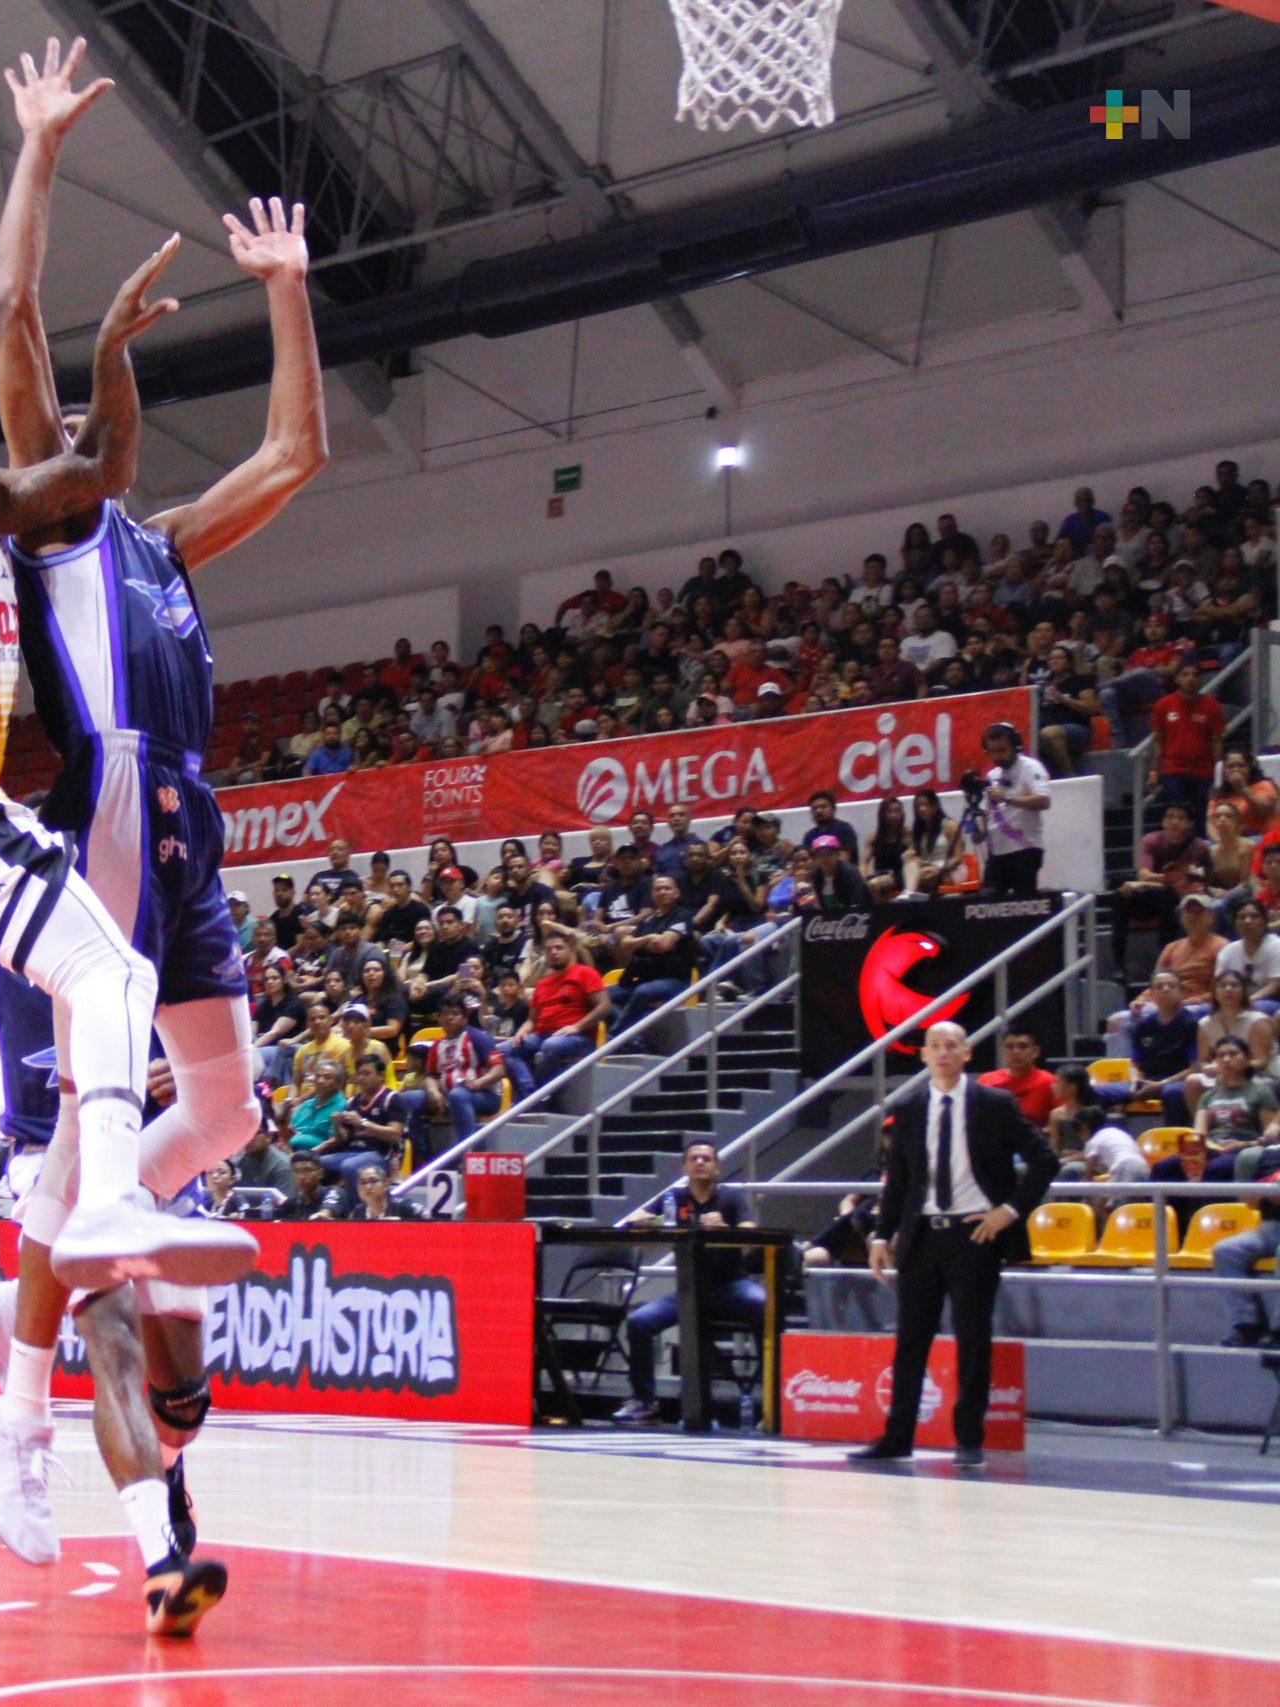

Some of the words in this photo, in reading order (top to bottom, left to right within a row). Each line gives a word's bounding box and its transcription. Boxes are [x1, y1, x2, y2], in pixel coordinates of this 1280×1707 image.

[838, 712, 952, 793] ciel
[423, 766, 472, 788] FOUR
[632, 747, 775, 807] MEGA
[422, 784, 484, 809] POINTS
[221, 781, 347, 853] omex
[964, 899, 1052, 920] POWERADE
[489, 1157, 522, 1176] IRS
[431, 1172, 453, 1218] 2
